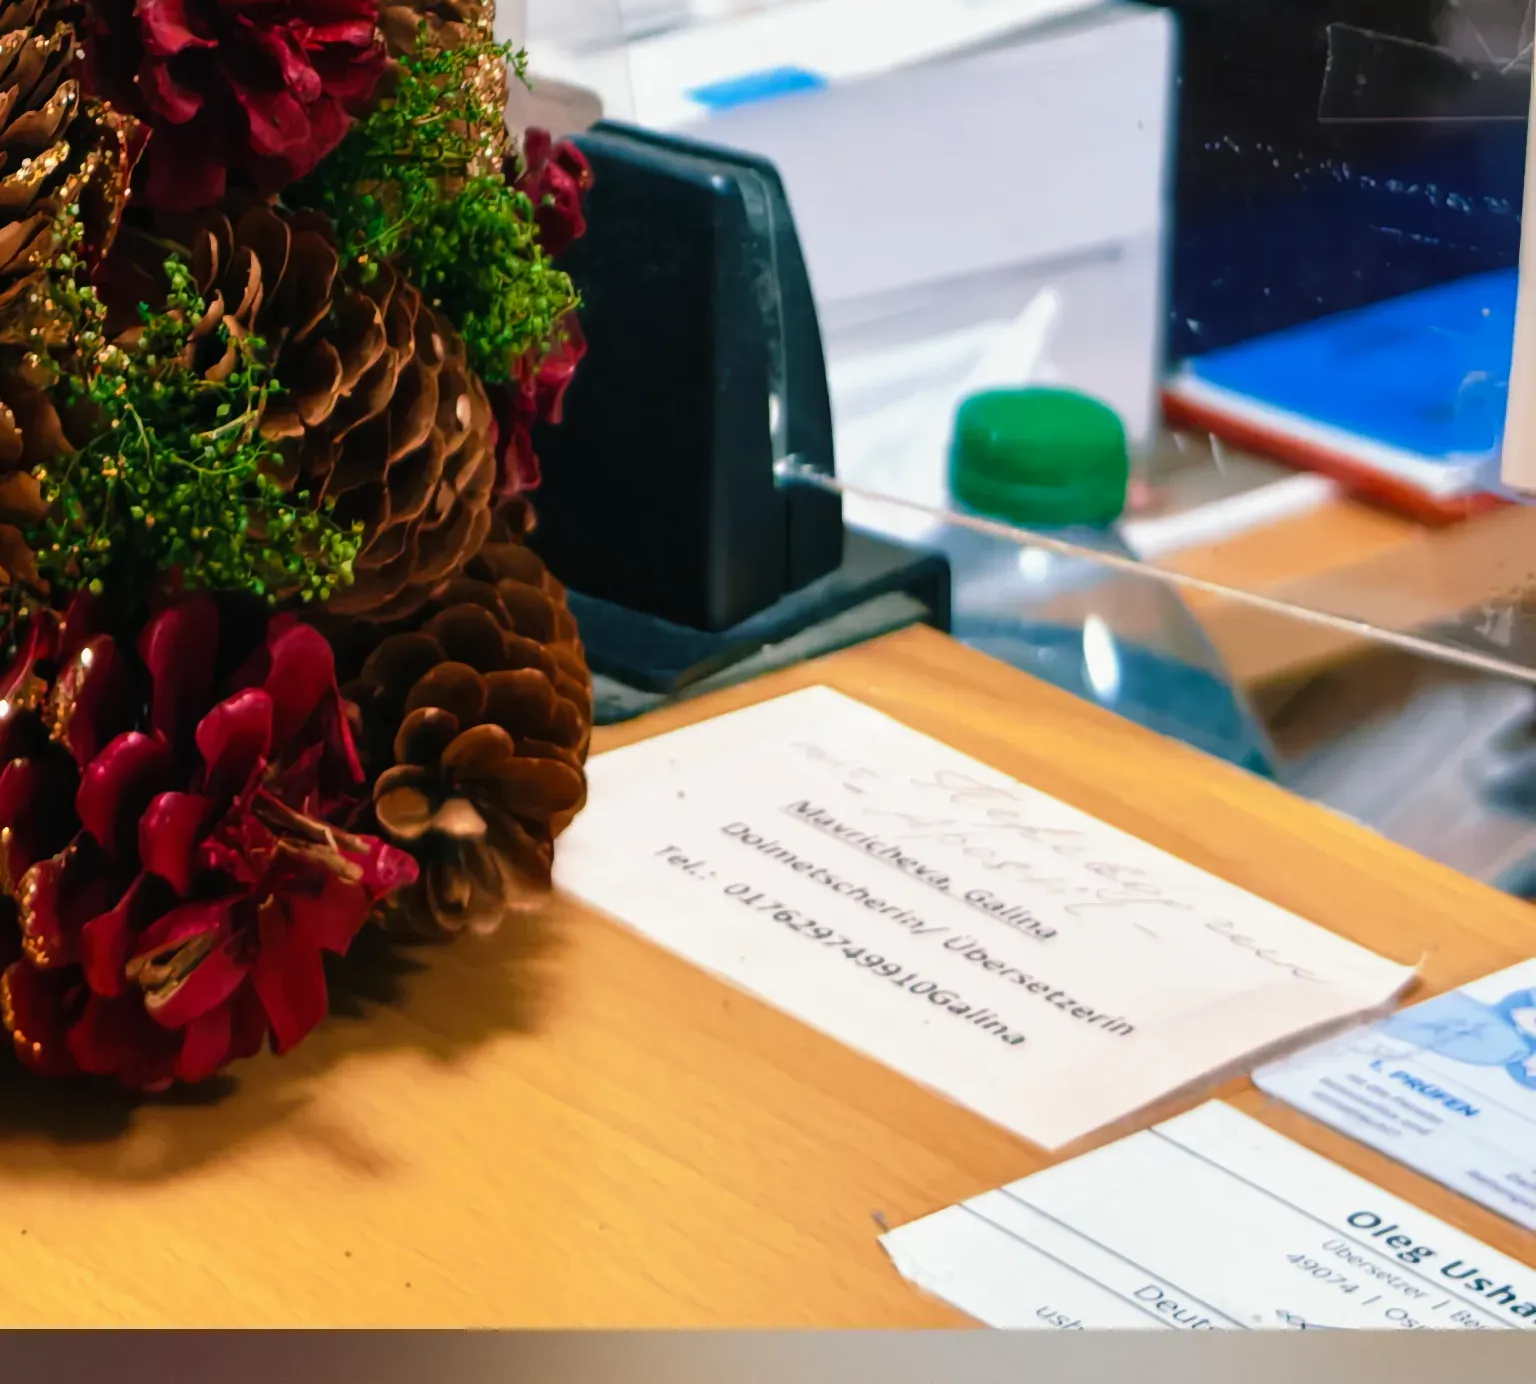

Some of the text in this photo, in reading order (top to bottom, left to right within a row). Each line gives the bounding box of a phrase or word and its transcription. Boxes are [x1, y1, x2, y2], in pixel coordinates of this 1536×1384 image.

[654, 845, 717, 881] Tel.:
[783, 800, 1058, 939] Mavricheva, Galina
[721, 821, 951, 935] Dolmetscherin/
[942, 935, 1136, 1036] Übersetzerin
[1388, 1069, 1481, 1118] PRÜFEN
[1286, 1252, 1362, 1295] 49074
[1321, 1238, 1429, 1300] Übersetzer
[1346, 1211, 1536, 1318] Oleg Usha
[1133, 1284, 1214, 1329] Deut
